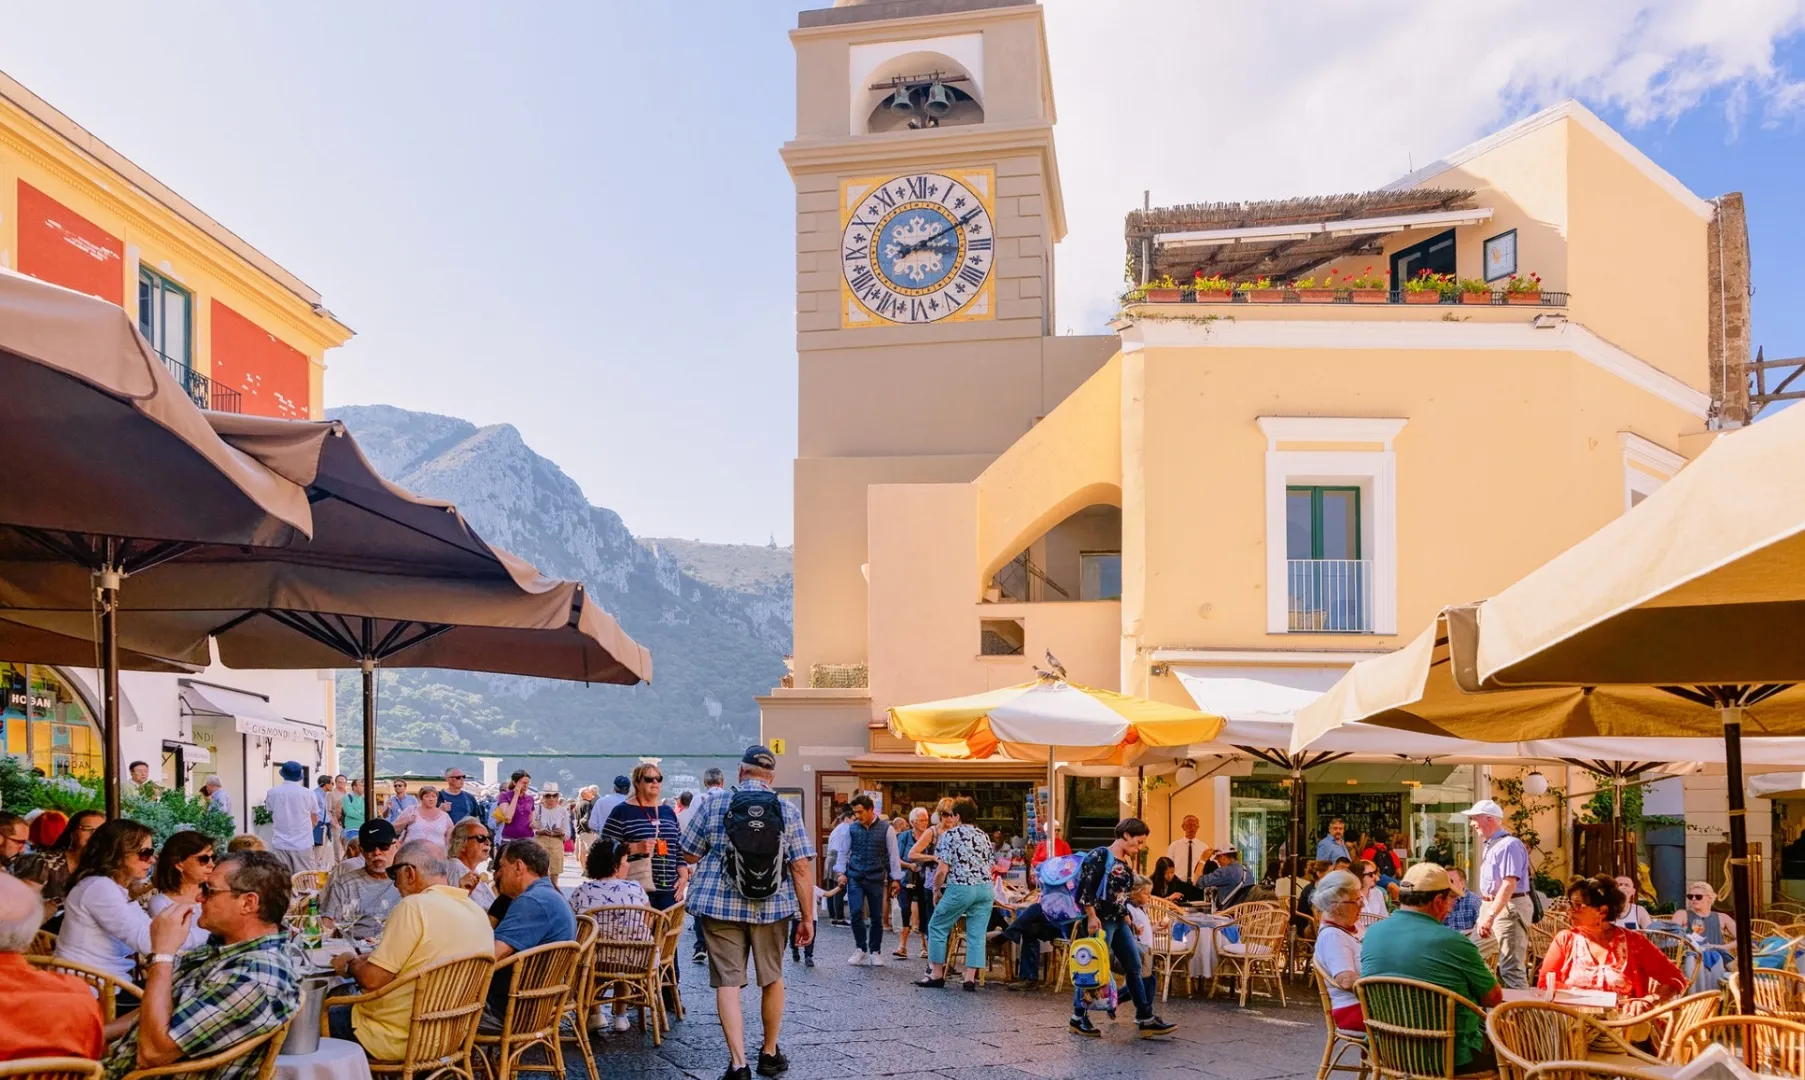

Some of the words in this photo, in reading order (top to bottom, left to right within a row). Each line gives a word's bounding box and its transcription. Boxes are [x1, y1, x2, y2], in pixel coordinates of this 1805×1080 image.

[906, 177, 927, 200] XII
[941, 183, 955, 204] I
[873, 187, 895, 212] XI
[851, 214, 876, 232] X
[845, 245, 868, 261] IX
[968, 238, 992, 251] III
[850, 270, 877, 301] VIII
[958, 265, 986, 288] IIII
[875, 291, 897, 318] VII
[911, 299, 929, 321] VI
[944, 291, 962, 312] V
[11, 694, 51, 708] HOGAN
